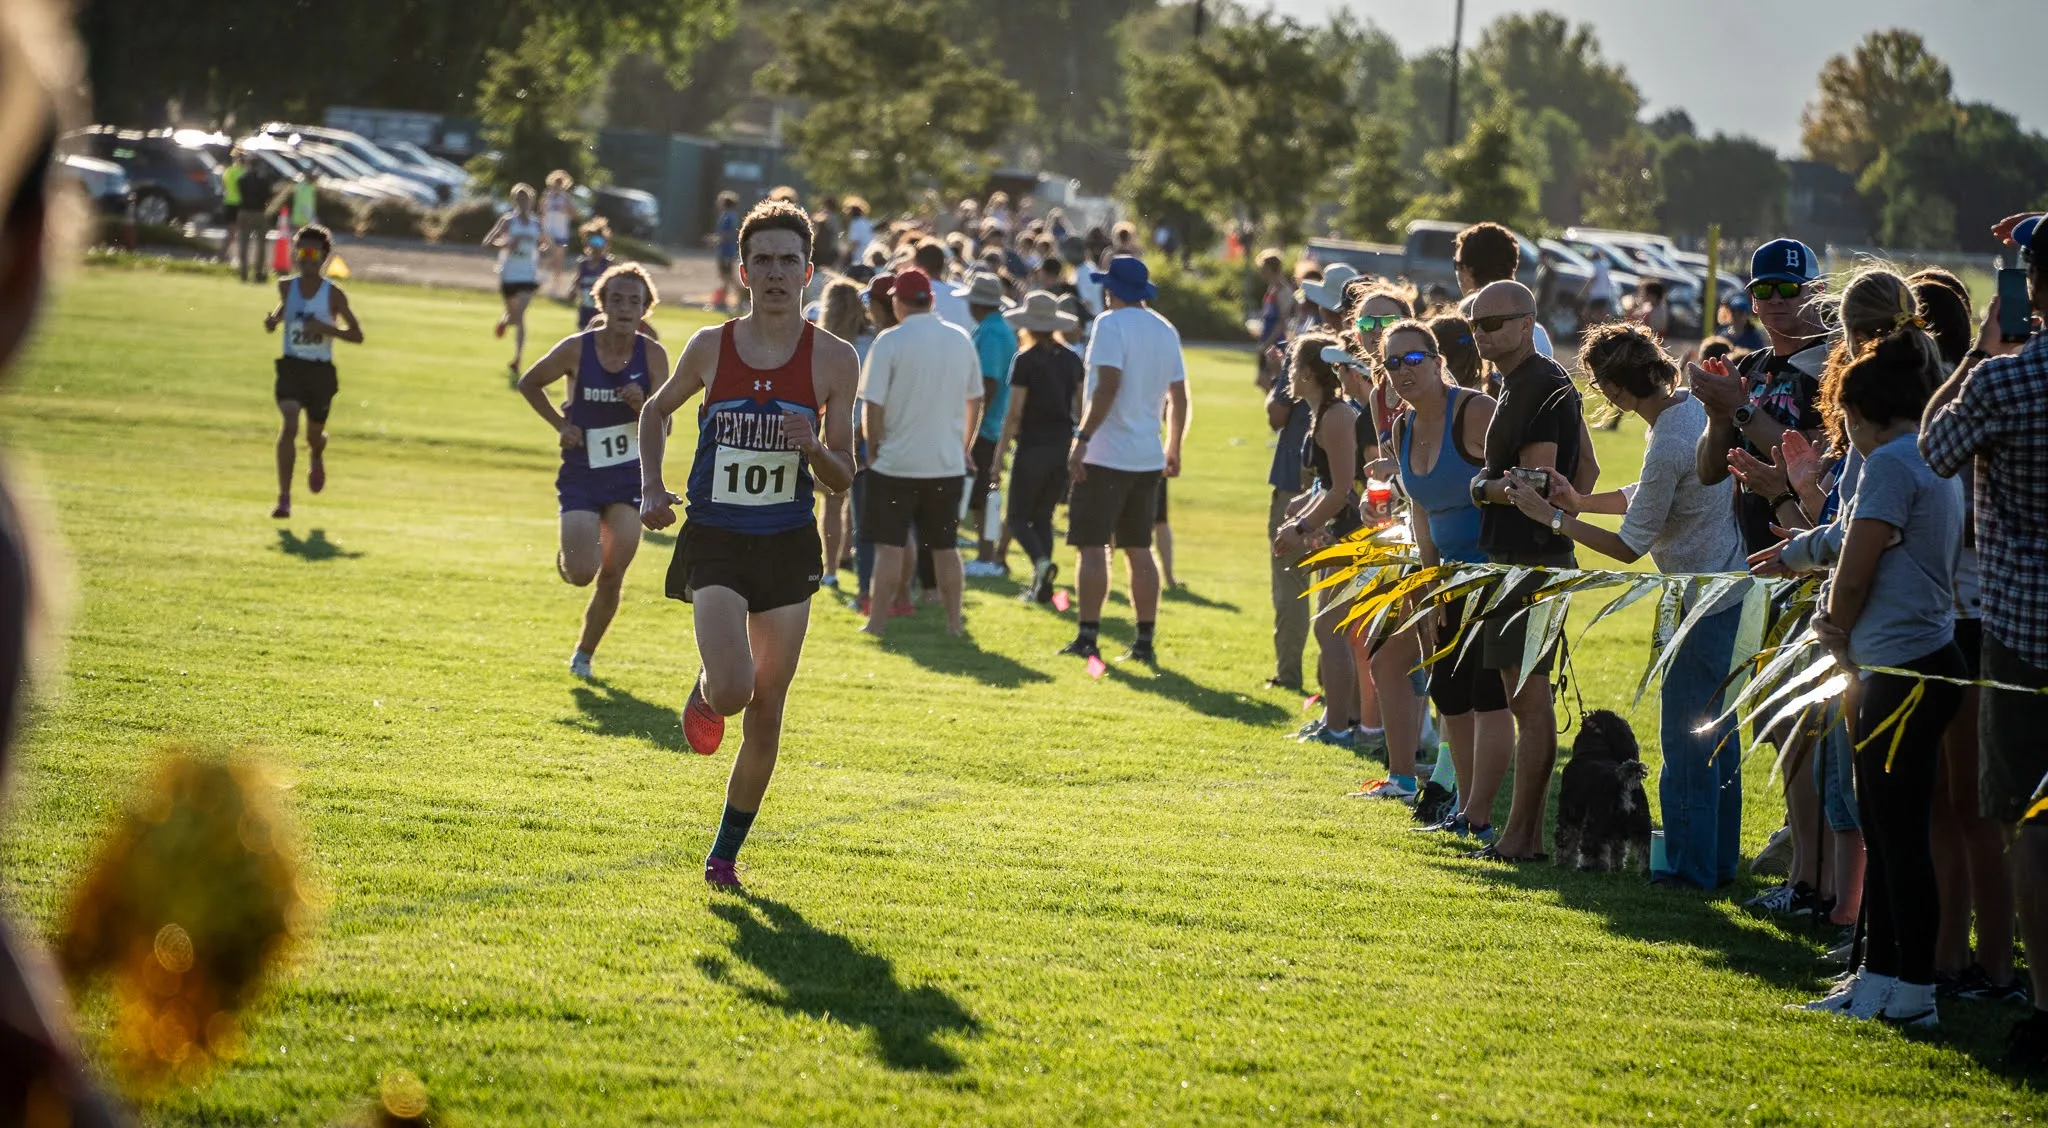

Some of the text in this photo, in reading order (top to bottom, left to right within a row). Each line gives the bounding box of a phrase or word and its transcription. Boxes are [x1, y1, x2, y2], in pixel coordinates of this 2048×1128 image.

[1785, 248, 1800, 268] B
[583, 387, 624, 403] BOUL
[601, 434, 629, 458] 19
[723, 462, 786, 495] 101
